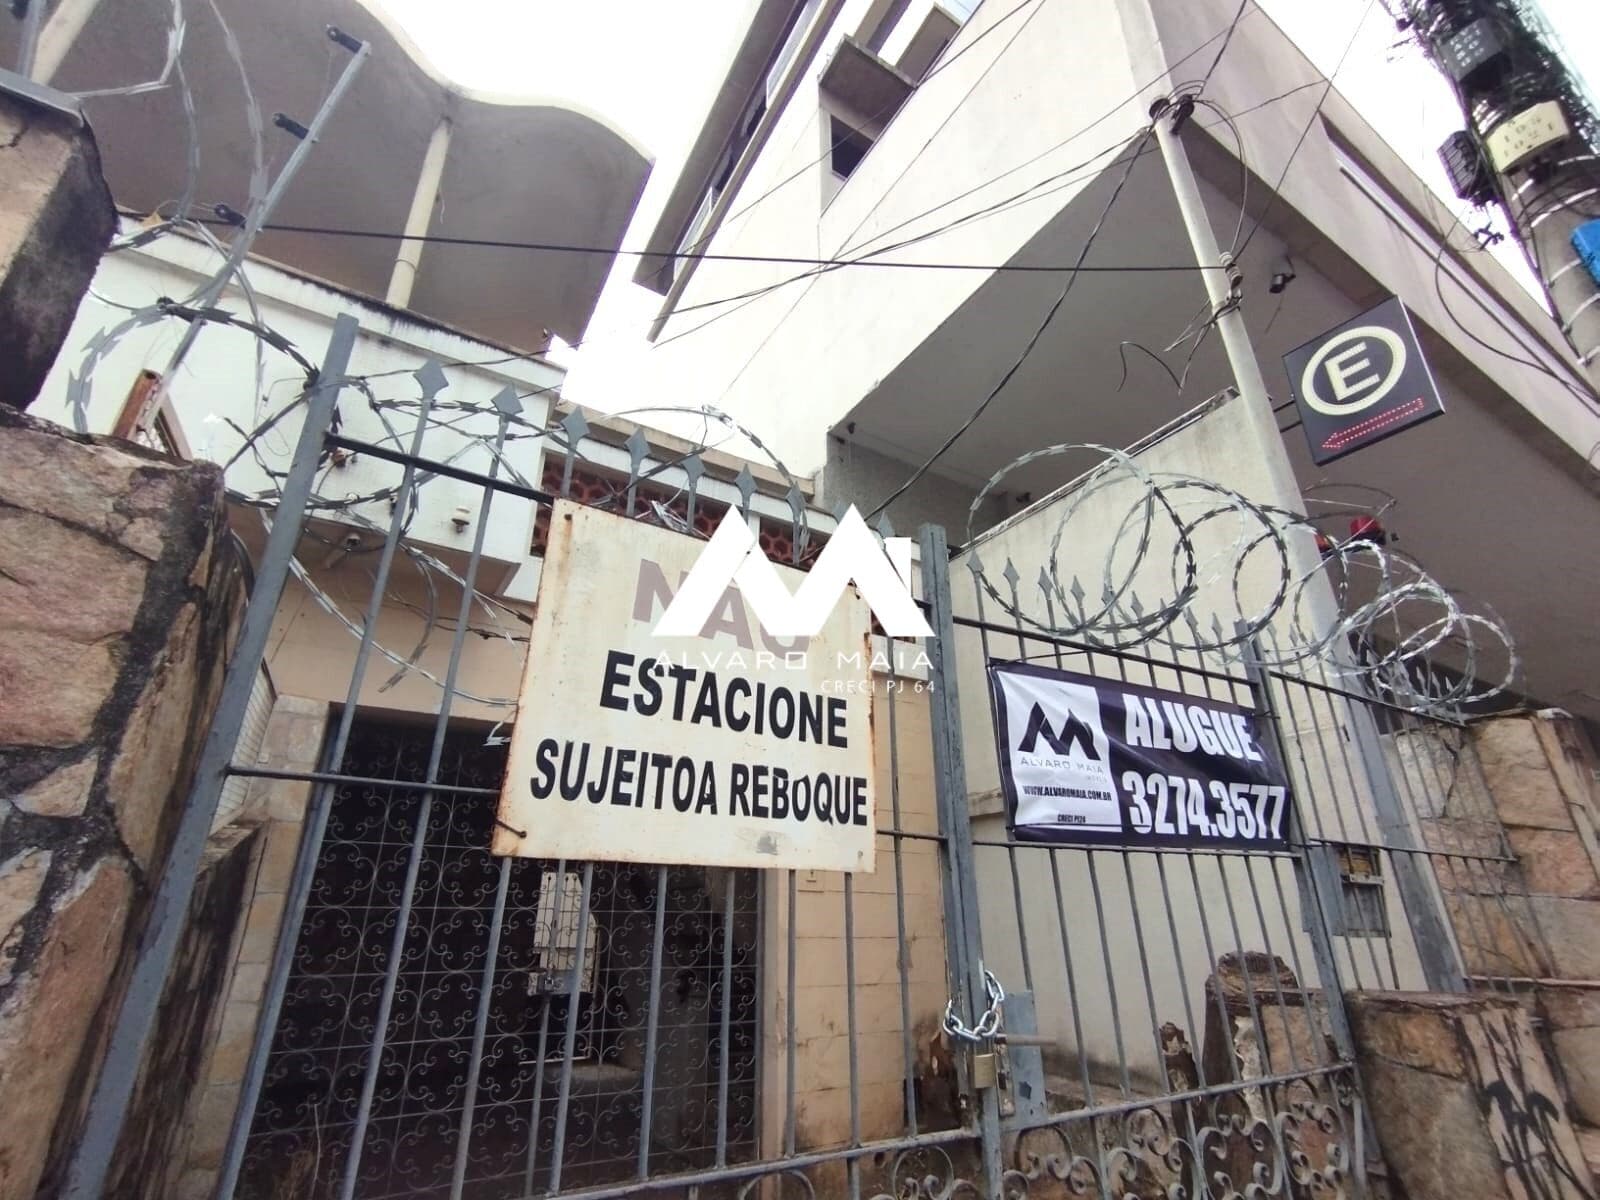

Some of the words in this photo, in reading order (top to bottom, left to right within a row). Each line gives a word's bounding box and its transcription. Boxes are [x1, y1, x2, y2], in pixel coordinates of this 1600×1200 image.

[1325, 341, 1380, 401] E
[600, 649, 848, 748] ESTACIONE
[1122, 693, 1263, 761] ALUGUE
[729, 763, 867, 826] REBOQUE
[1020, 756, 1071, 769] ALVARO
[1122, 770, 1285, 839] 3274.3577
